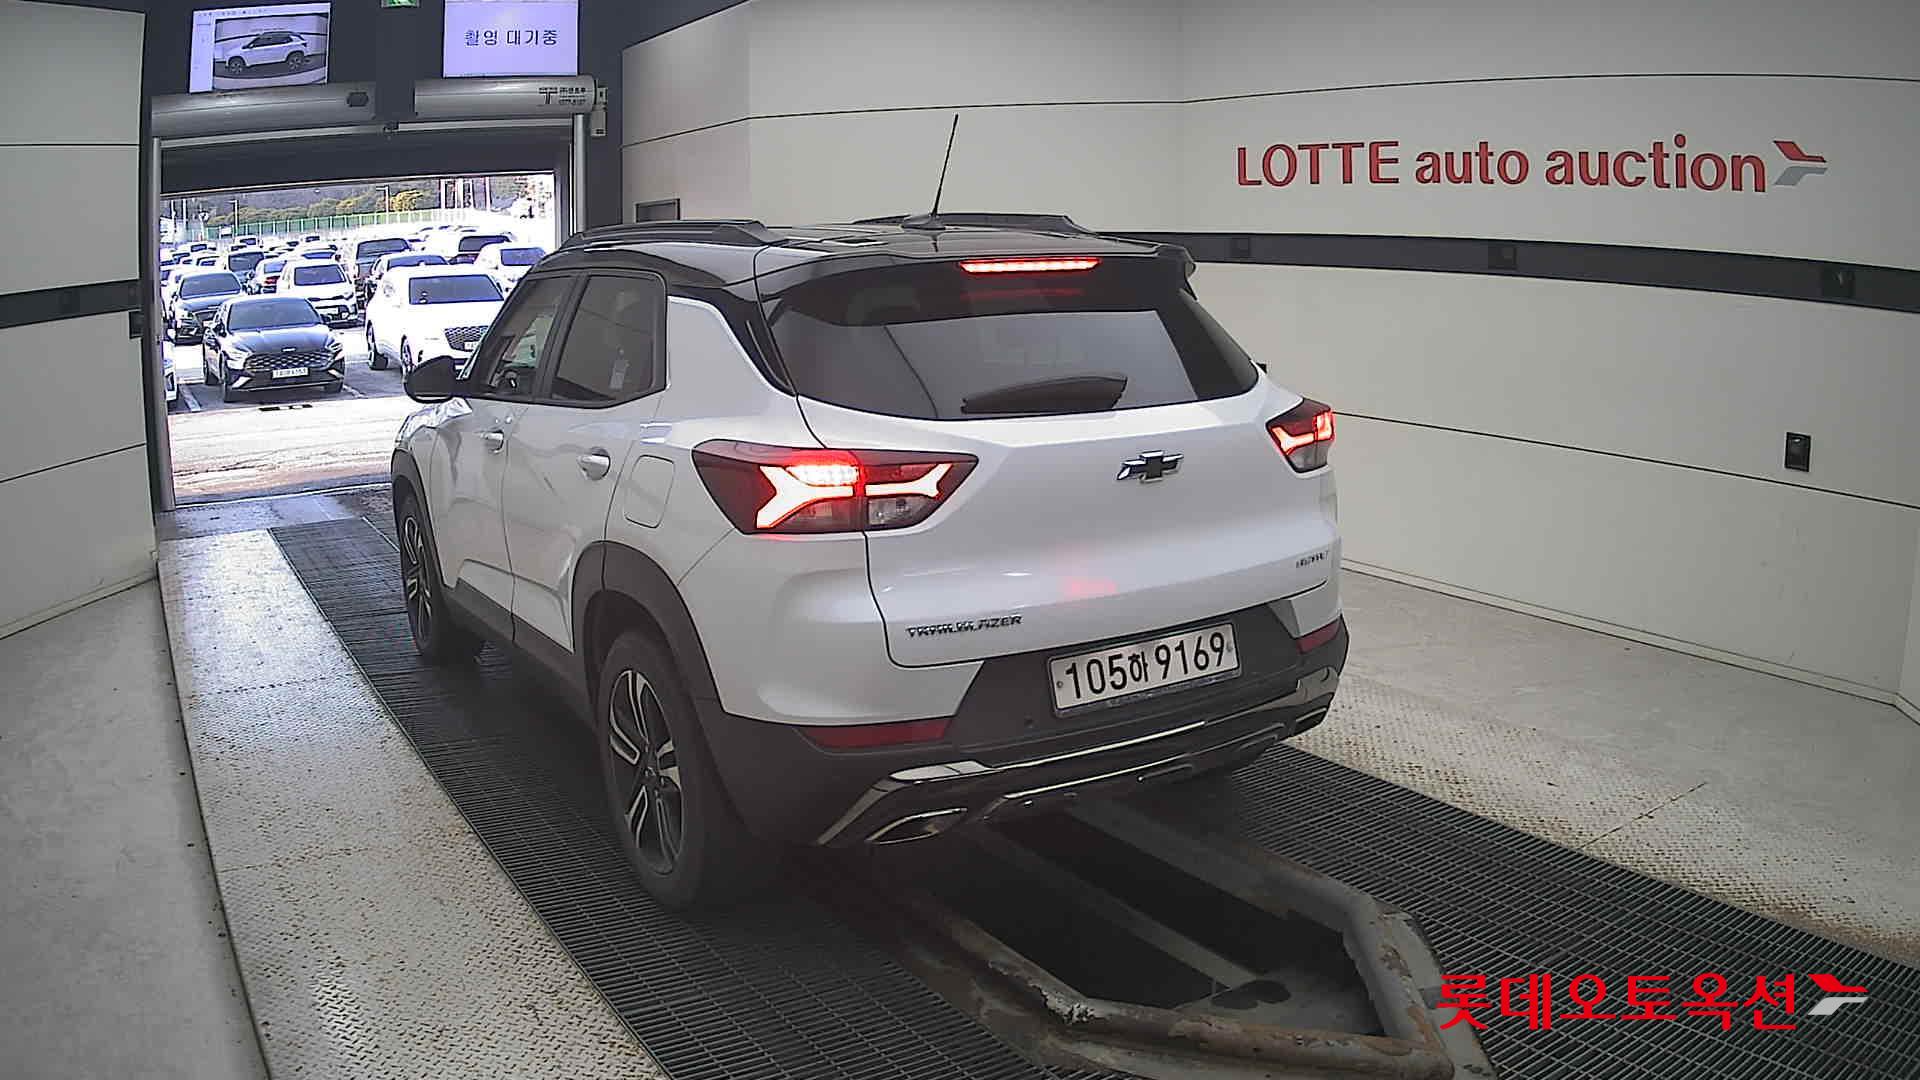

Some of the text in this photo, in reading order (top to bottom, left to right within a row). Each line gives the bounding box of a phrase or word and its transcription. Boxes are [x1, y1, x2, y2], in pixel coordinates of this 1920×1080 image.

[506, 29, 559, 46] 대기중
[1237, 134, 1767, 192] LOTTE auto auction
[1065, 632, 1225, 699] 105하 9169
